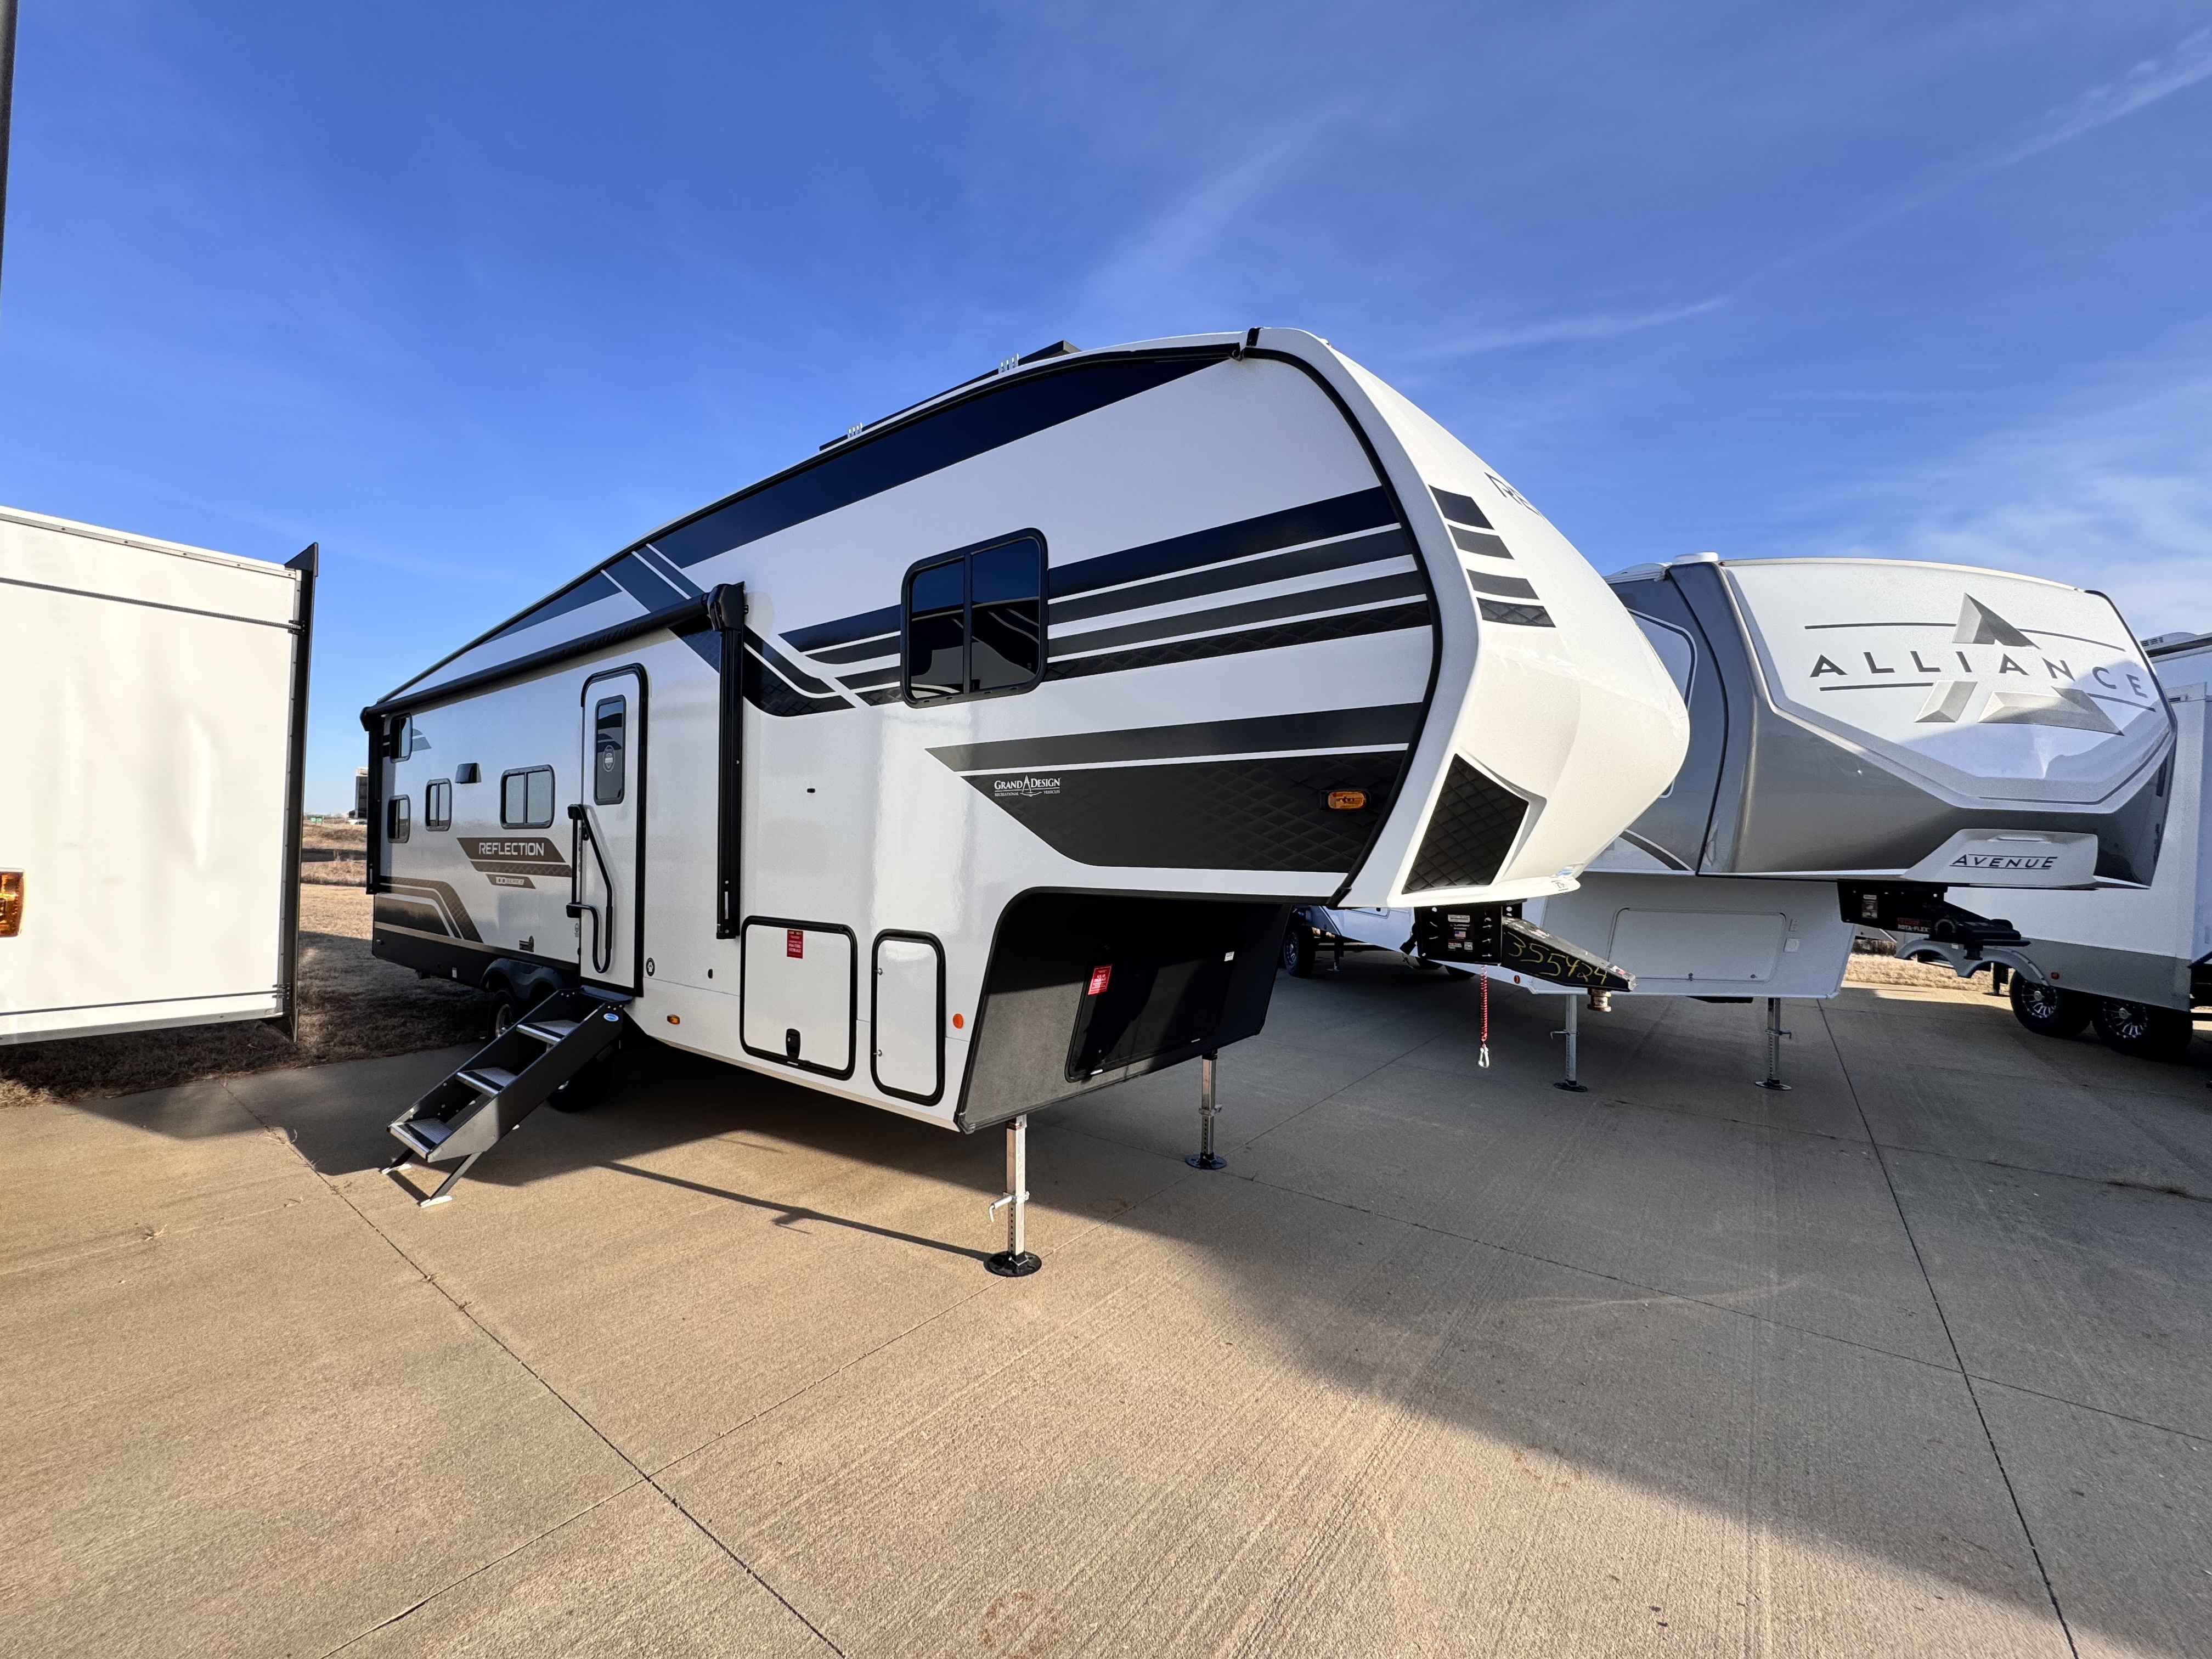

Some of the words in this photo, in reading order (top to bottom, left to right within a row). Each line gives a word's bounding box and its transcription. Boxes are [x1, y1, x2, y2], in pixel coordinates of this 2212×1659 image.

[1809, 651, 2148, 699] ALLIANCE
[994, 780, 1023, 790] GRAND
[1030, 777, 1060, 788] DESIGN
[478, 842, 545, 856] REFLECTION
[1951, 854, 2058, 868] AVENUE
[1508, 931, 1608, 986] 355424
